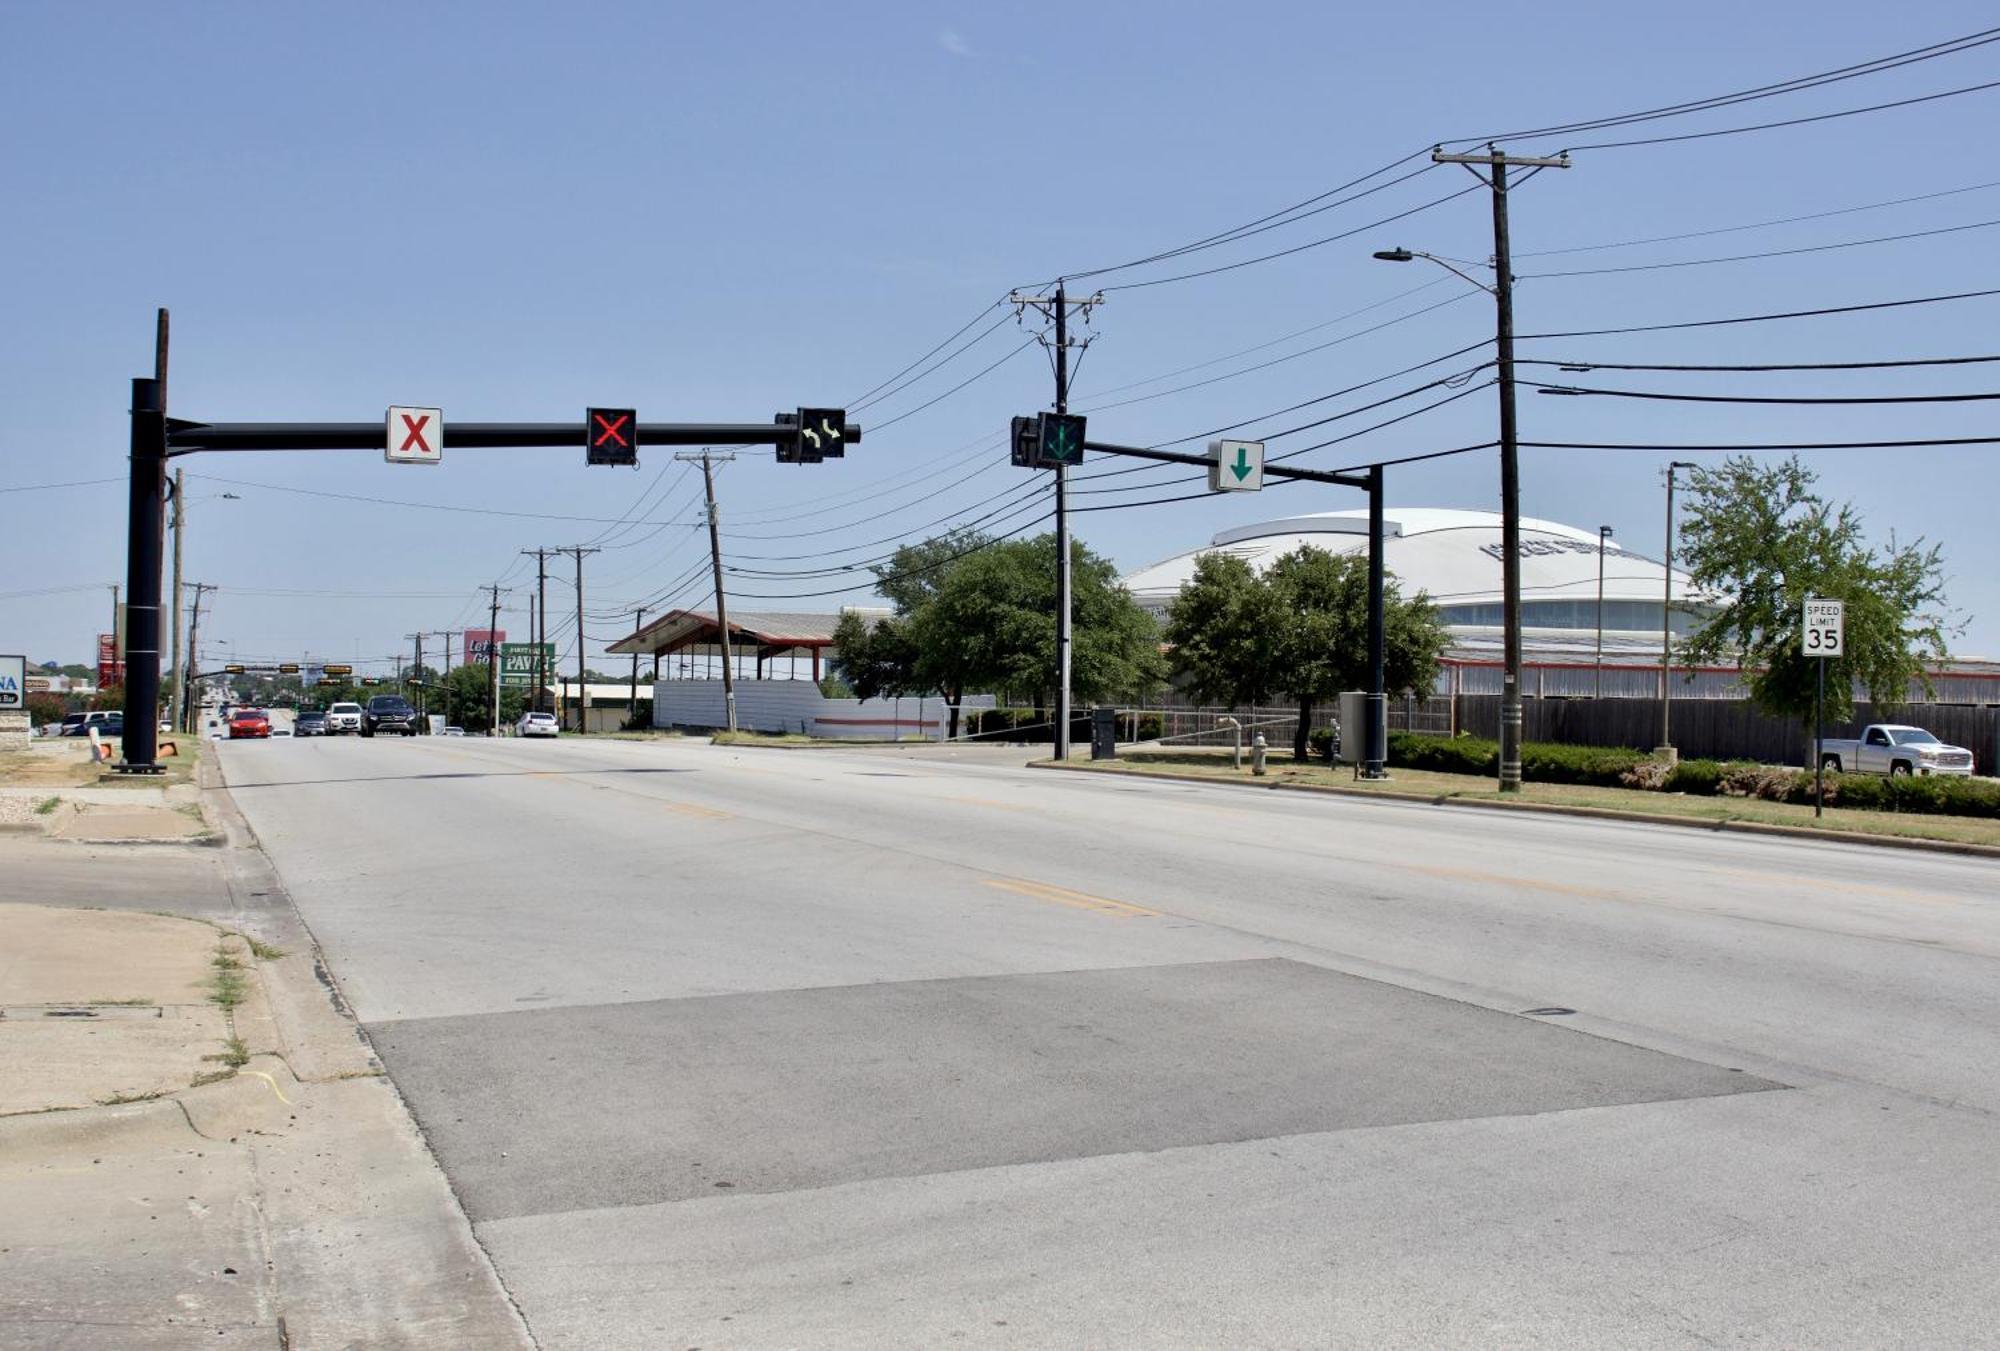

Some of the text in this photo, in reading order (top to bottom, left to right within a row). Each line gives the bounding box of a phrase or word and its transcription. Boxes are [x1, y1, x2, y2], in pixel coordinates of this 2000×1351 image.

[1807, 606, 1840, 616] SPEED
[1810, 618, 1836, 626] LIMIT
[1808, 629, 1838, 650] 35
